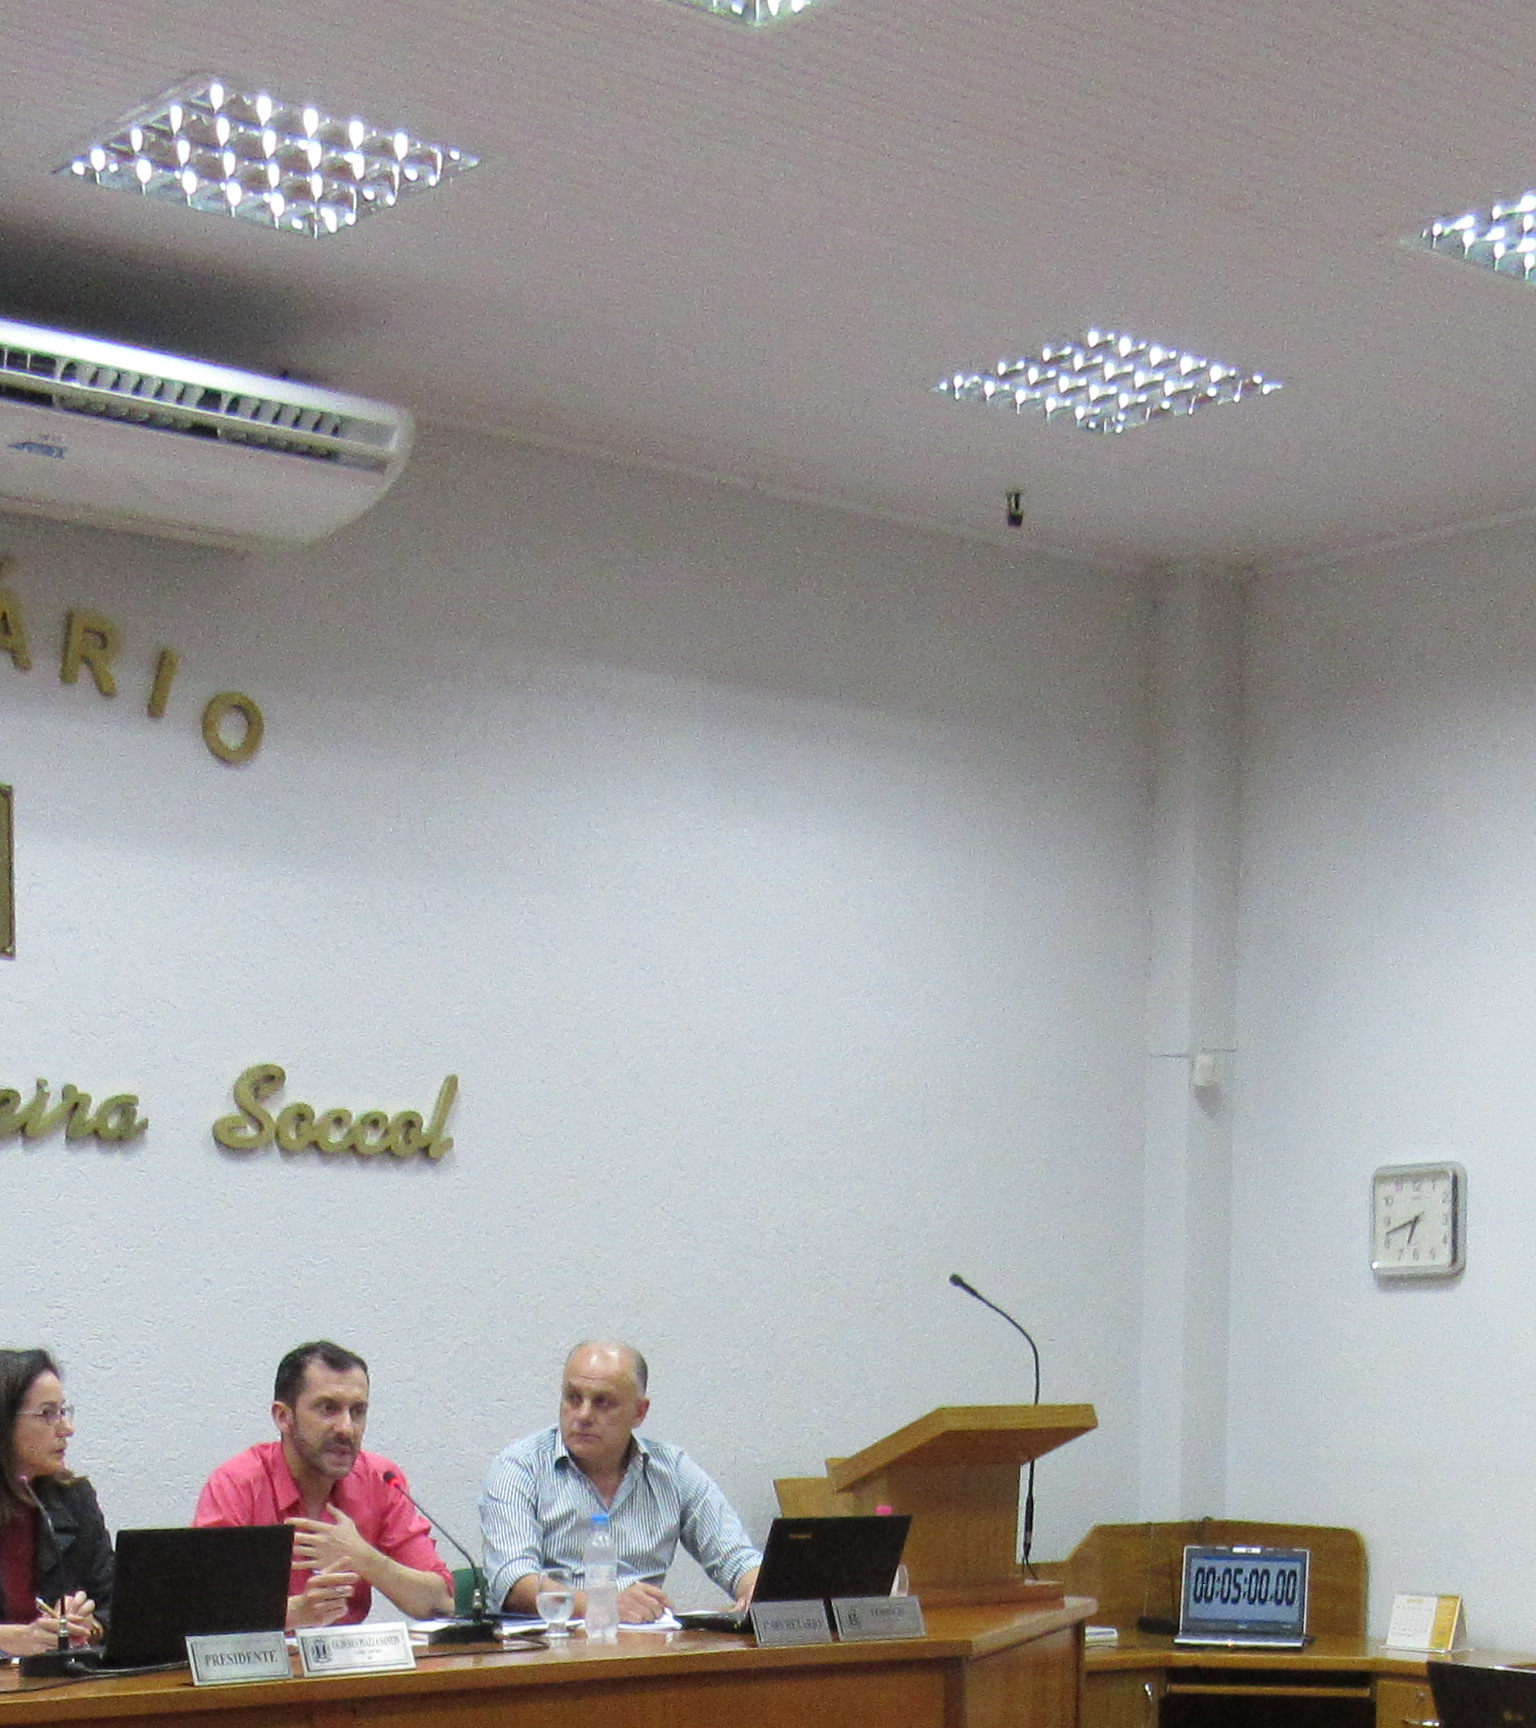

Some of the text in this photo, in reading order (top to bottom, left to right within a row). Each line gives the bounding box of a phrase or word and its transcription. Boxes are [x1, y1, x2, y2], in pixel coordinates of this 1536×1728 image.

[212, 1063, 460, 1158] Soccol
[1193, 1566, 1297, 1606] 00:05:00.00
[204, 1650, 278, 1668] PRESIDENTE
